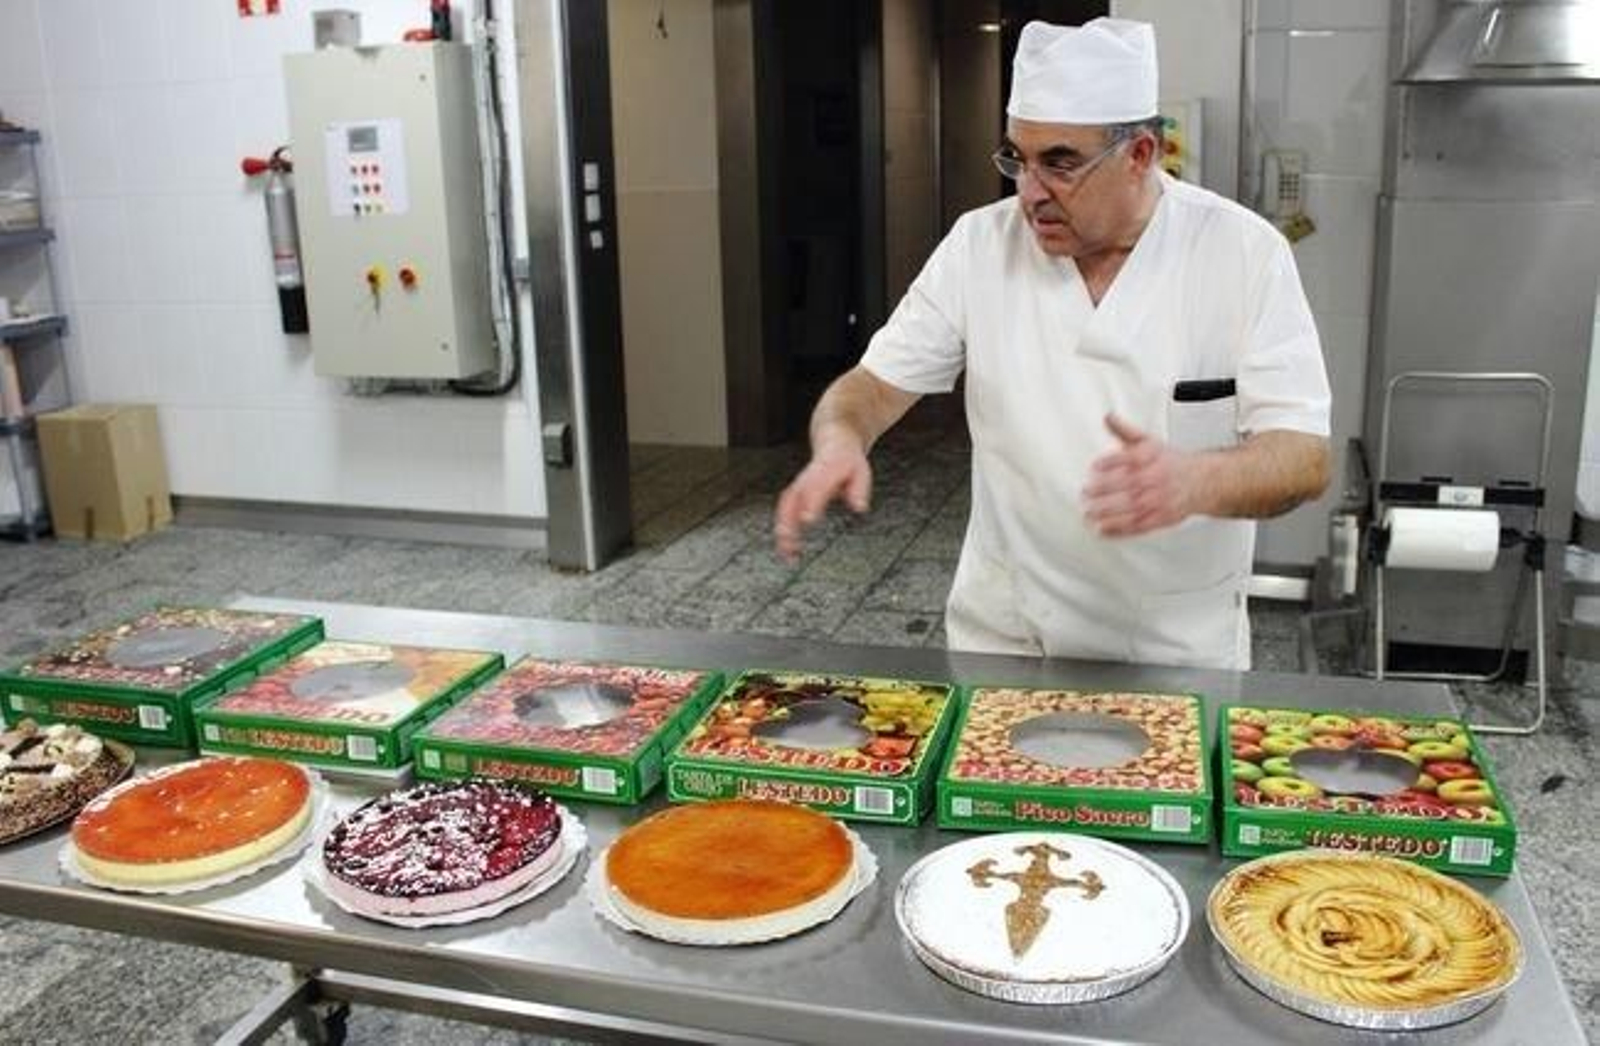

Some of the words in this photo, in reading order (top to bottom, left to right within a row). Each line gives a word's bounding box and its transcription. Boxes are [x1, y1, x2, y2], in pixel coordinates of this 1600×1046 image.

[737, 776, 850, 807] LESTEDO
[1014, 798, 1072, 824] Pico
[1074, 804, 1150, 827] Sacro
[1307, 828, 1446, 858] LESTEDO
